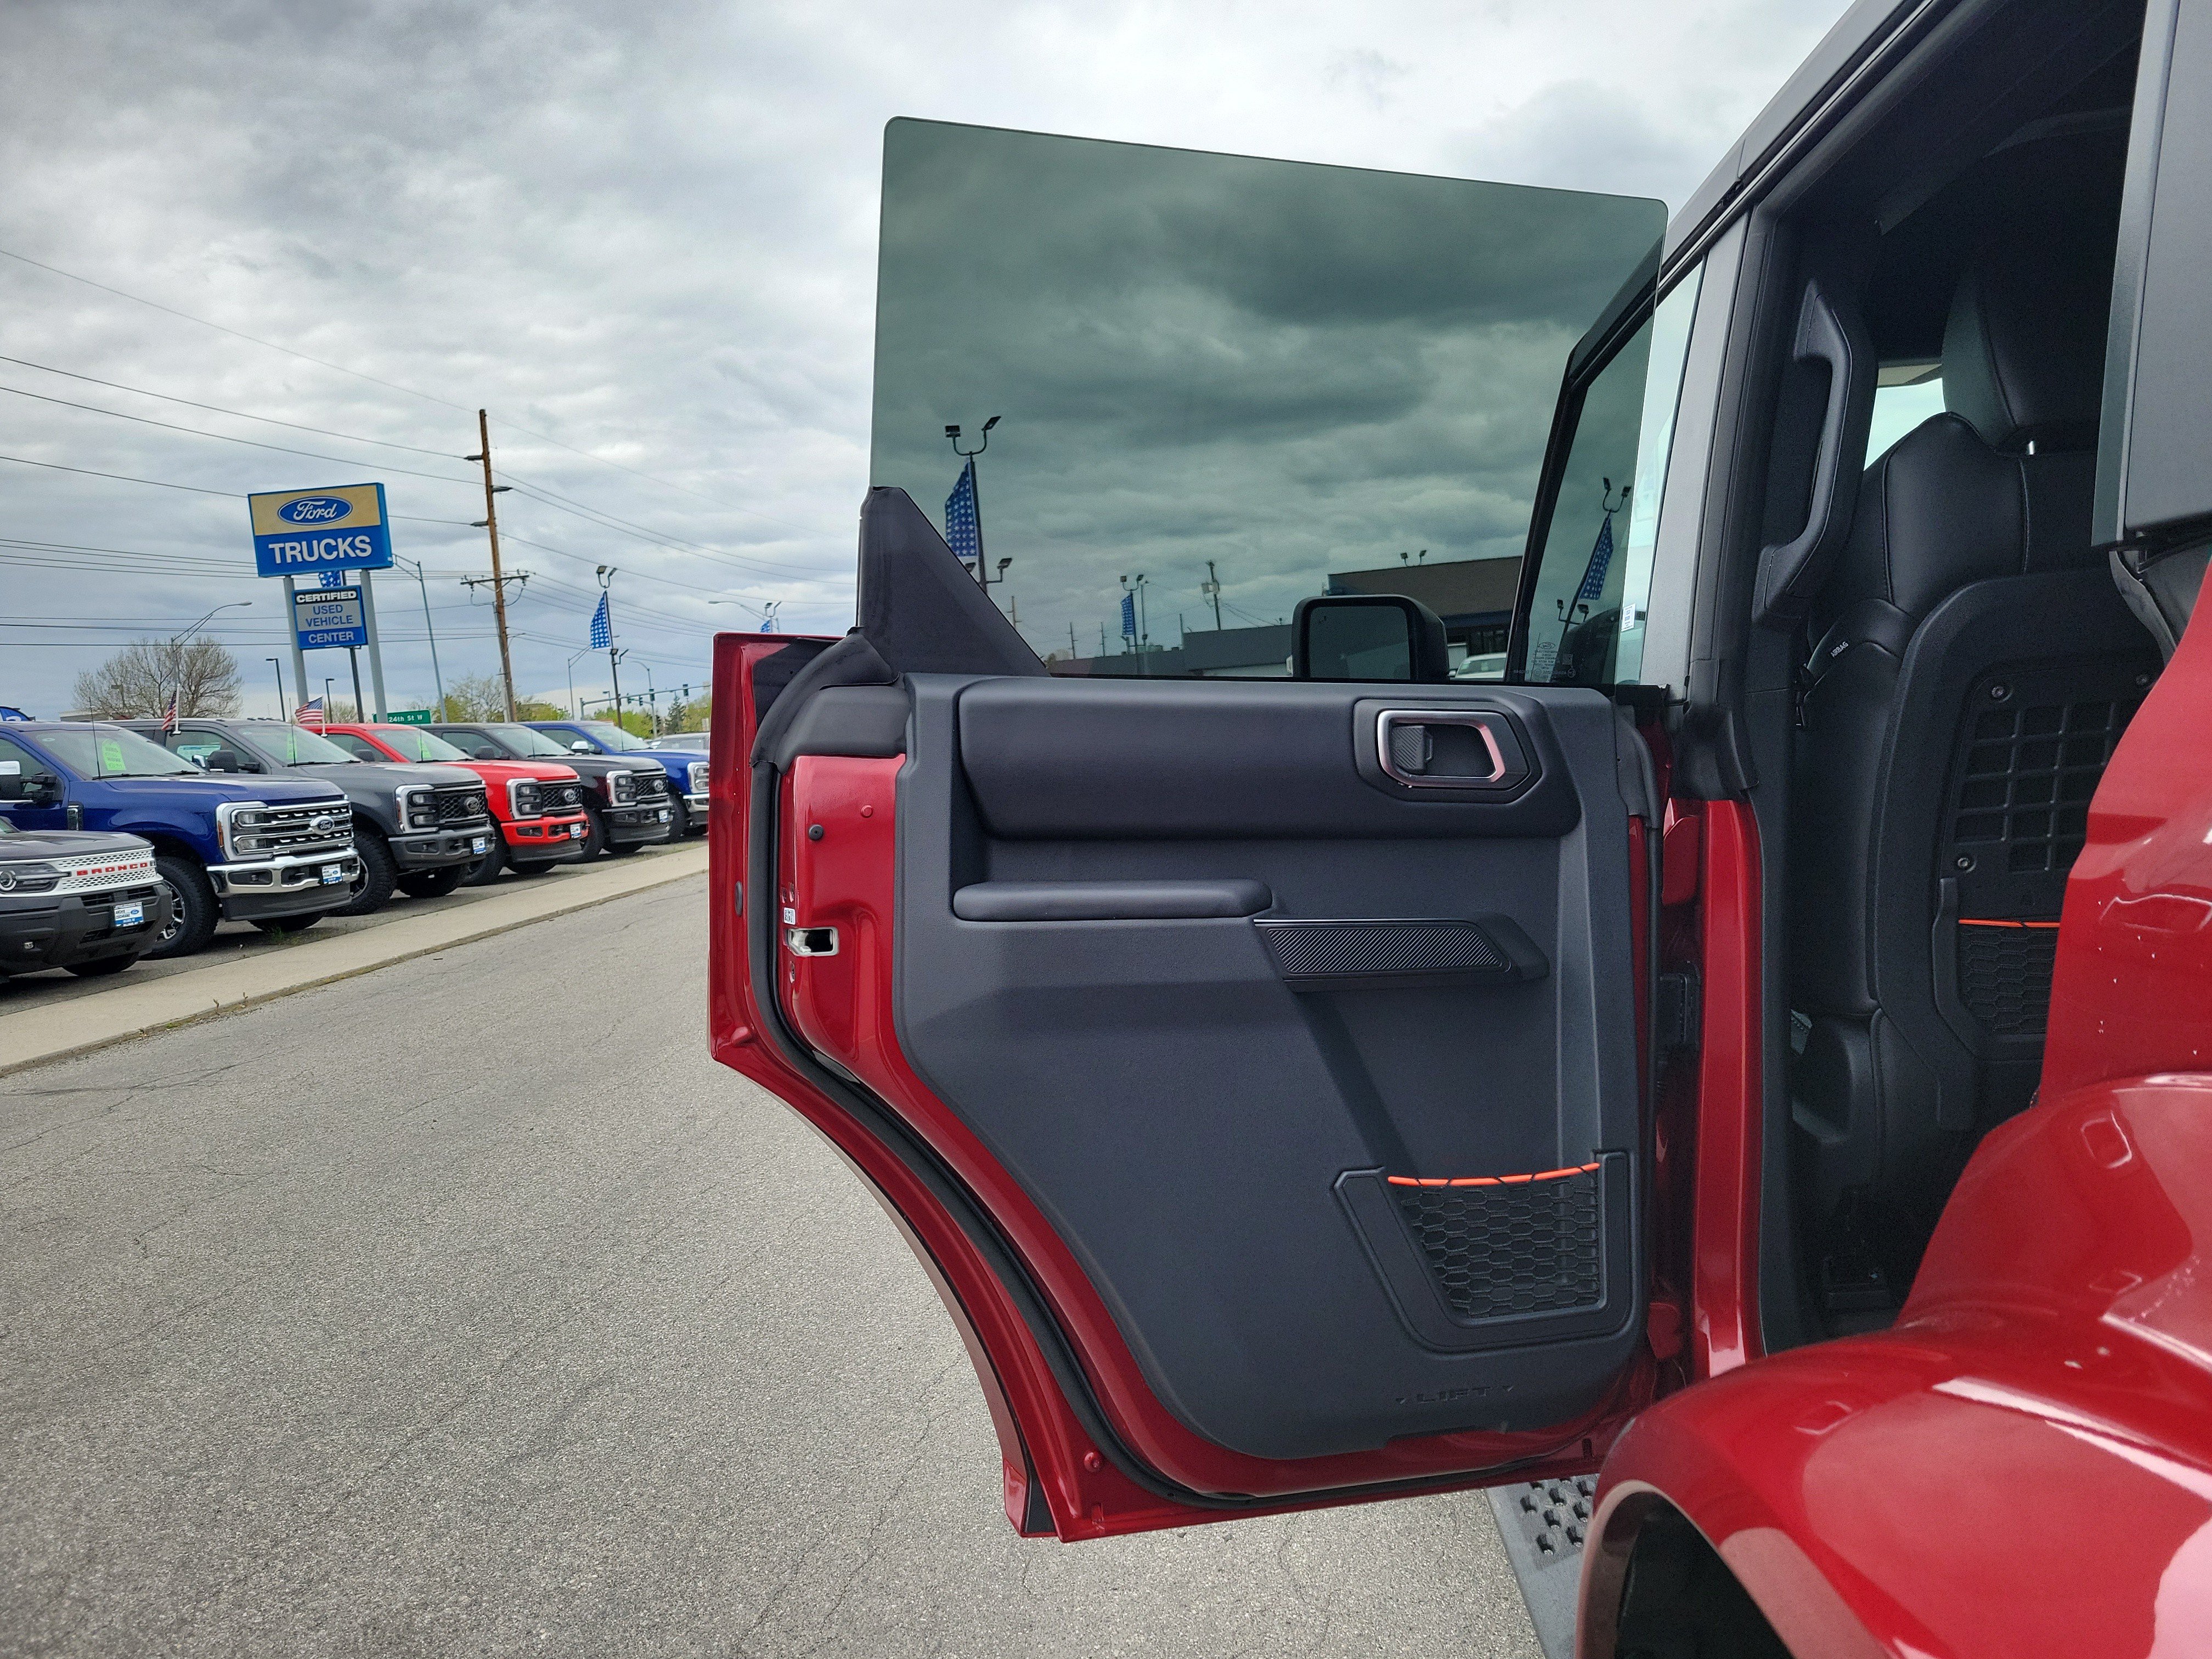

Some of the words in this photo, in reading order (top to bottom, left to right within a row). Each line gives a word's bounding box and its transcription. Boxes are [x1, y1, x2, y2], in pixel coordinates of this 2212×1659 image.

[293, 500, 337, 521] Ford
[268, 535, 372, 563] TRUCKS
[296, 591, 357, 603] CERTIFIED
[313, 605, 343, 614] USED
[306, 615, 353, 627] VEHICLE
[308, 631, 354, 644] CENTER
[1830, 641, 1849, 658] AIRBAG
[76, 862, 148, 876] BRONCO
